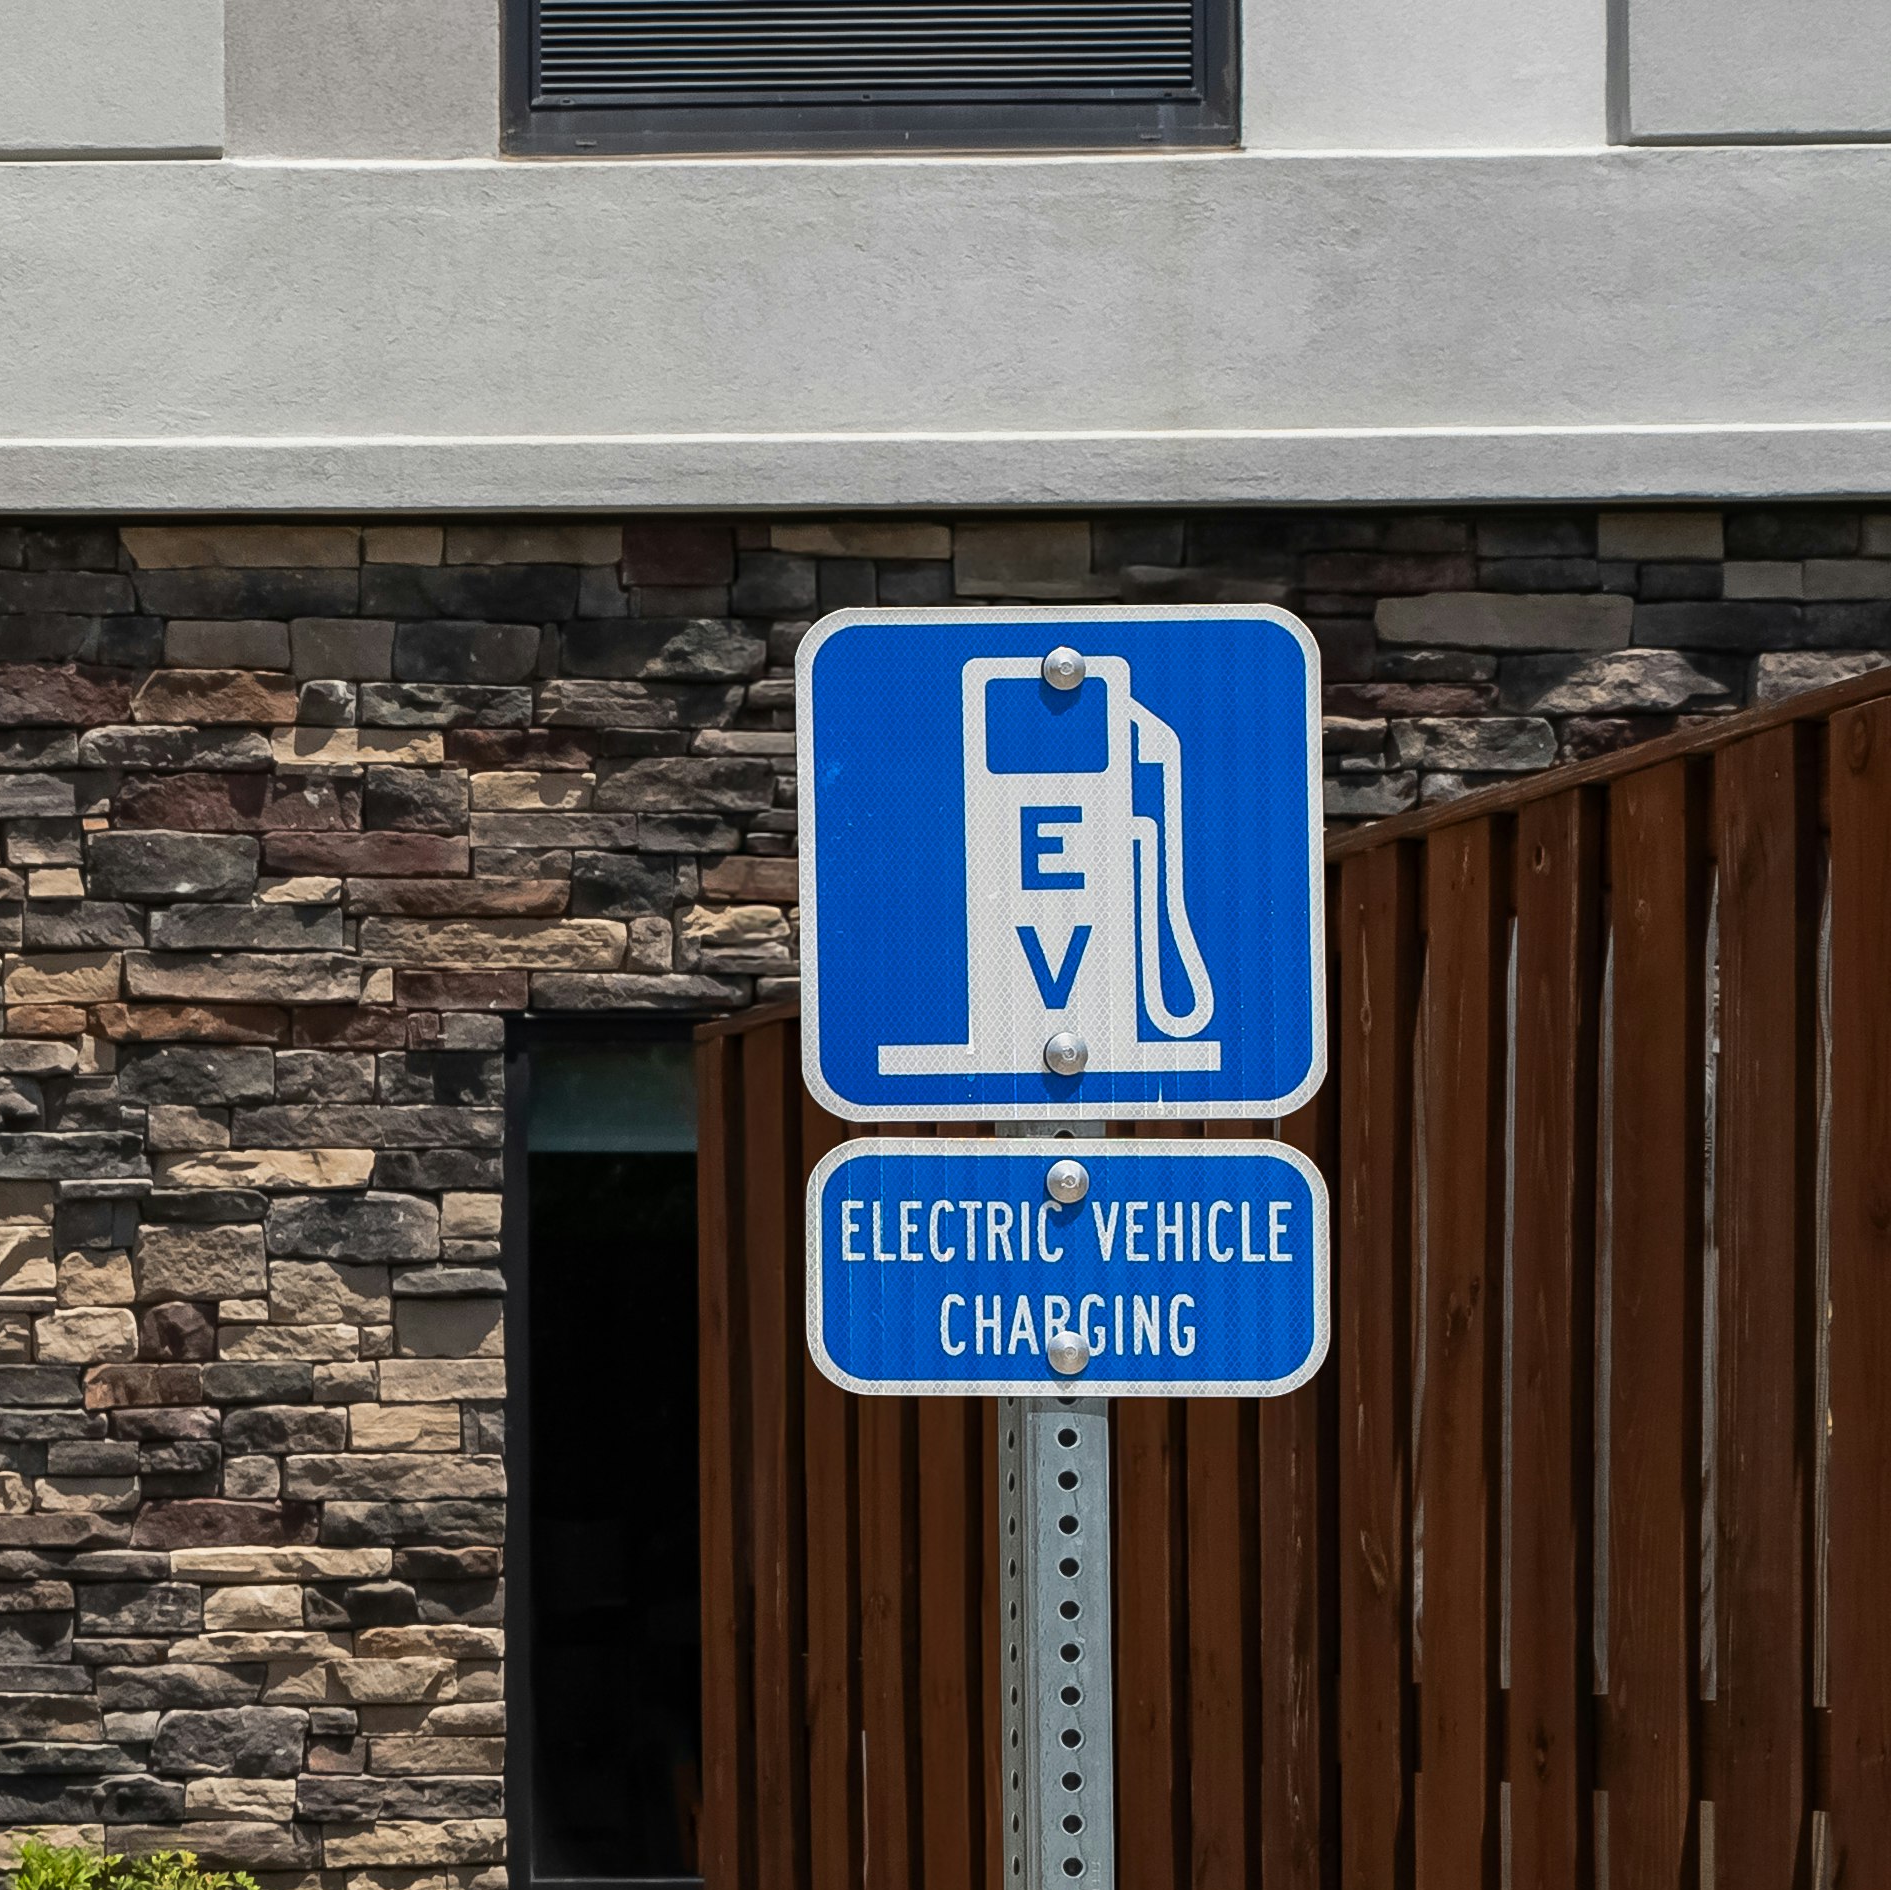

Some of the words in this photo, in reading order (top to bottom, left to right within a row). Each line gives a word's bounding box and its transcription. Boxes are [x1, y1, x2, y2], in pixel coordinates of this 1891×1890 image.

[841, 1199, 1065, 1263] ELECTRIC
[1092, 1199, 1294, 1262] VEHICLE
[940, 1292, 1197, 1357] CHARGING
